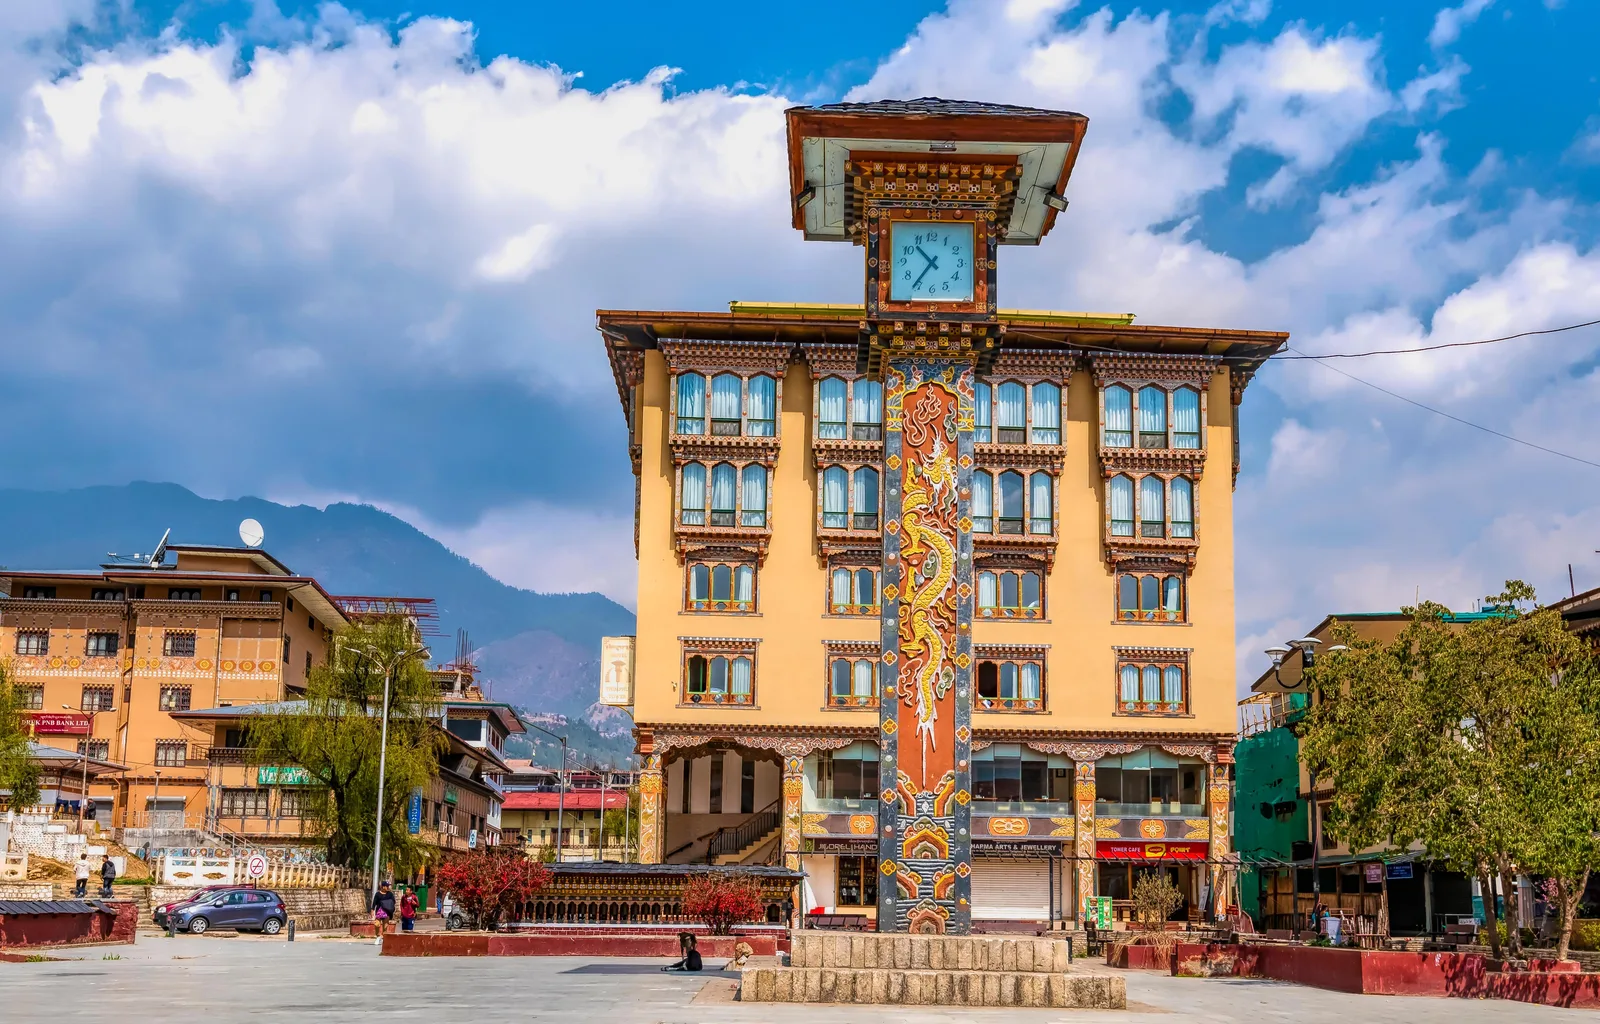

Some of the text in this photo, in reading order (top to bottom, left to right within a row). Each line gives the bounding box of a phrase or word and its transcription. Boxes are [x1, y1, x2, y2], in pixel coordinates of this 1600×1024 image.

[914, 235, 923, 245] 11
[926, 232, 938, 242] 12
[903, 245, 914, 255] 10
[951, 245, 960, 255] 2
[900, 257, 907, 267] 9
[956, 258, 964, 268] 3
[904, 270, 912, 280] 8
[951, 271, 960, 281] 4
[928, 284, 936, 293] 6
[942, 281, 949, 291] 5
